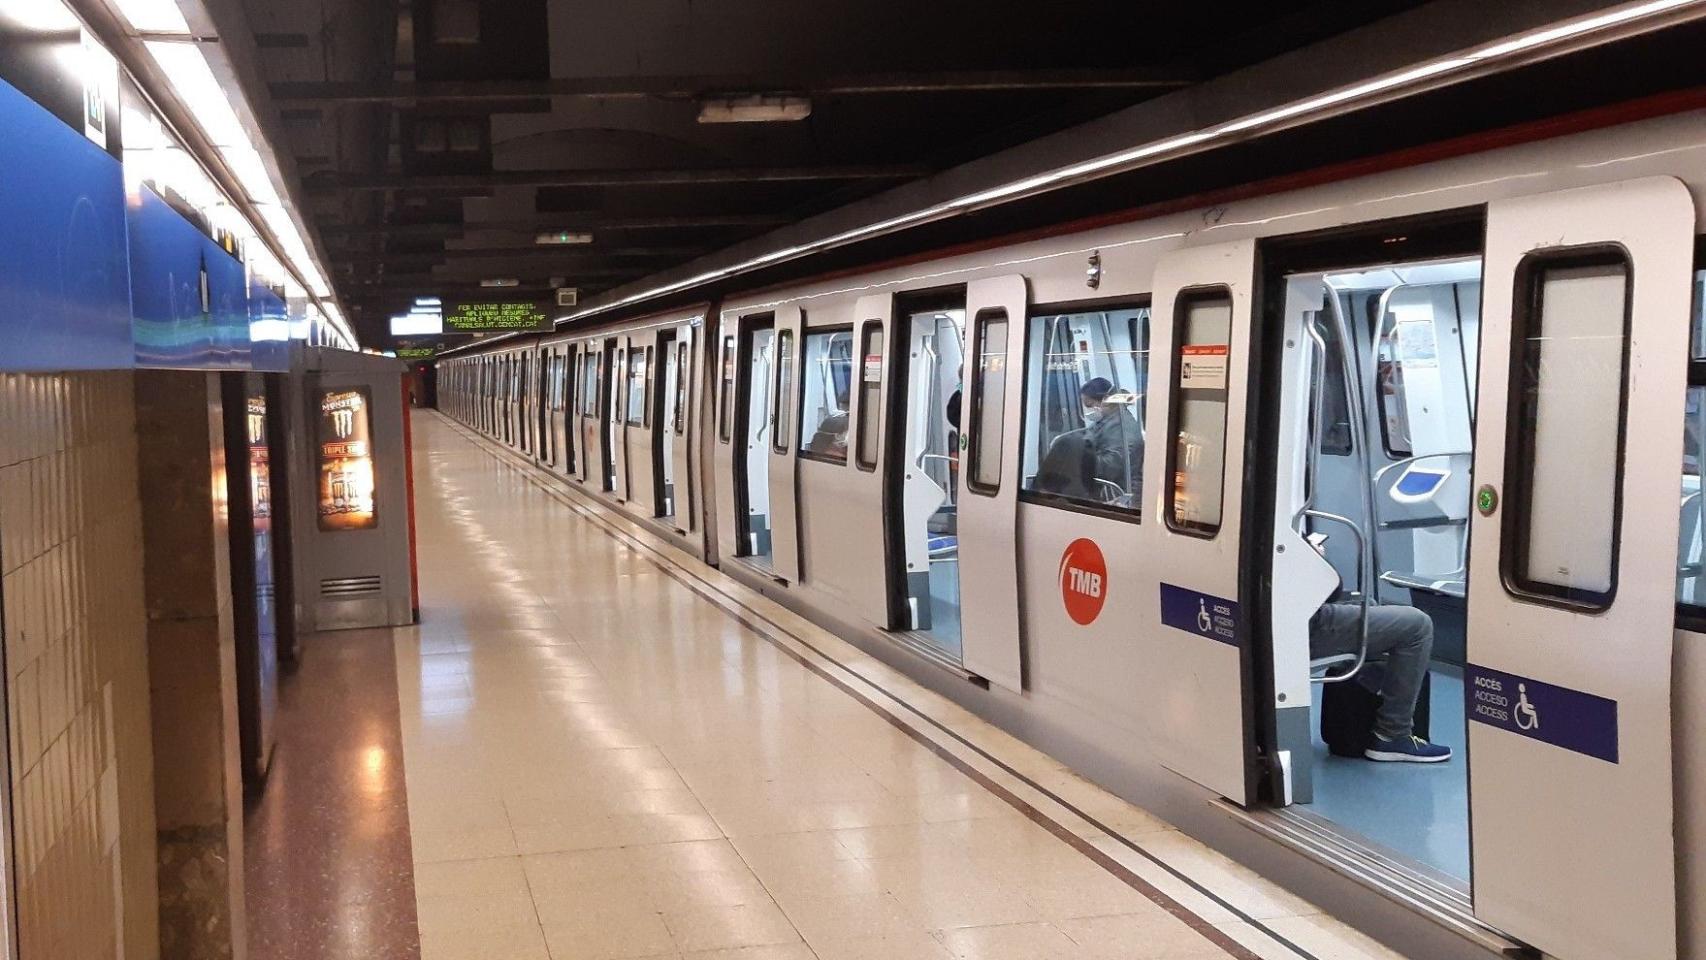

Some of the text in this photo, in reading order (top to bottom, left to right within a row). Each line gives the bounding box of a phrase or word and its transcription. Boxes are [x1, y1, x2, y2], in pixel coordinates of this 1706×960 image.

[1069, 567, 1101, 598] TMB
[1475, 690, 1508, 707] ACCESO
[1475, 704, 1508, 721] ACCESS
